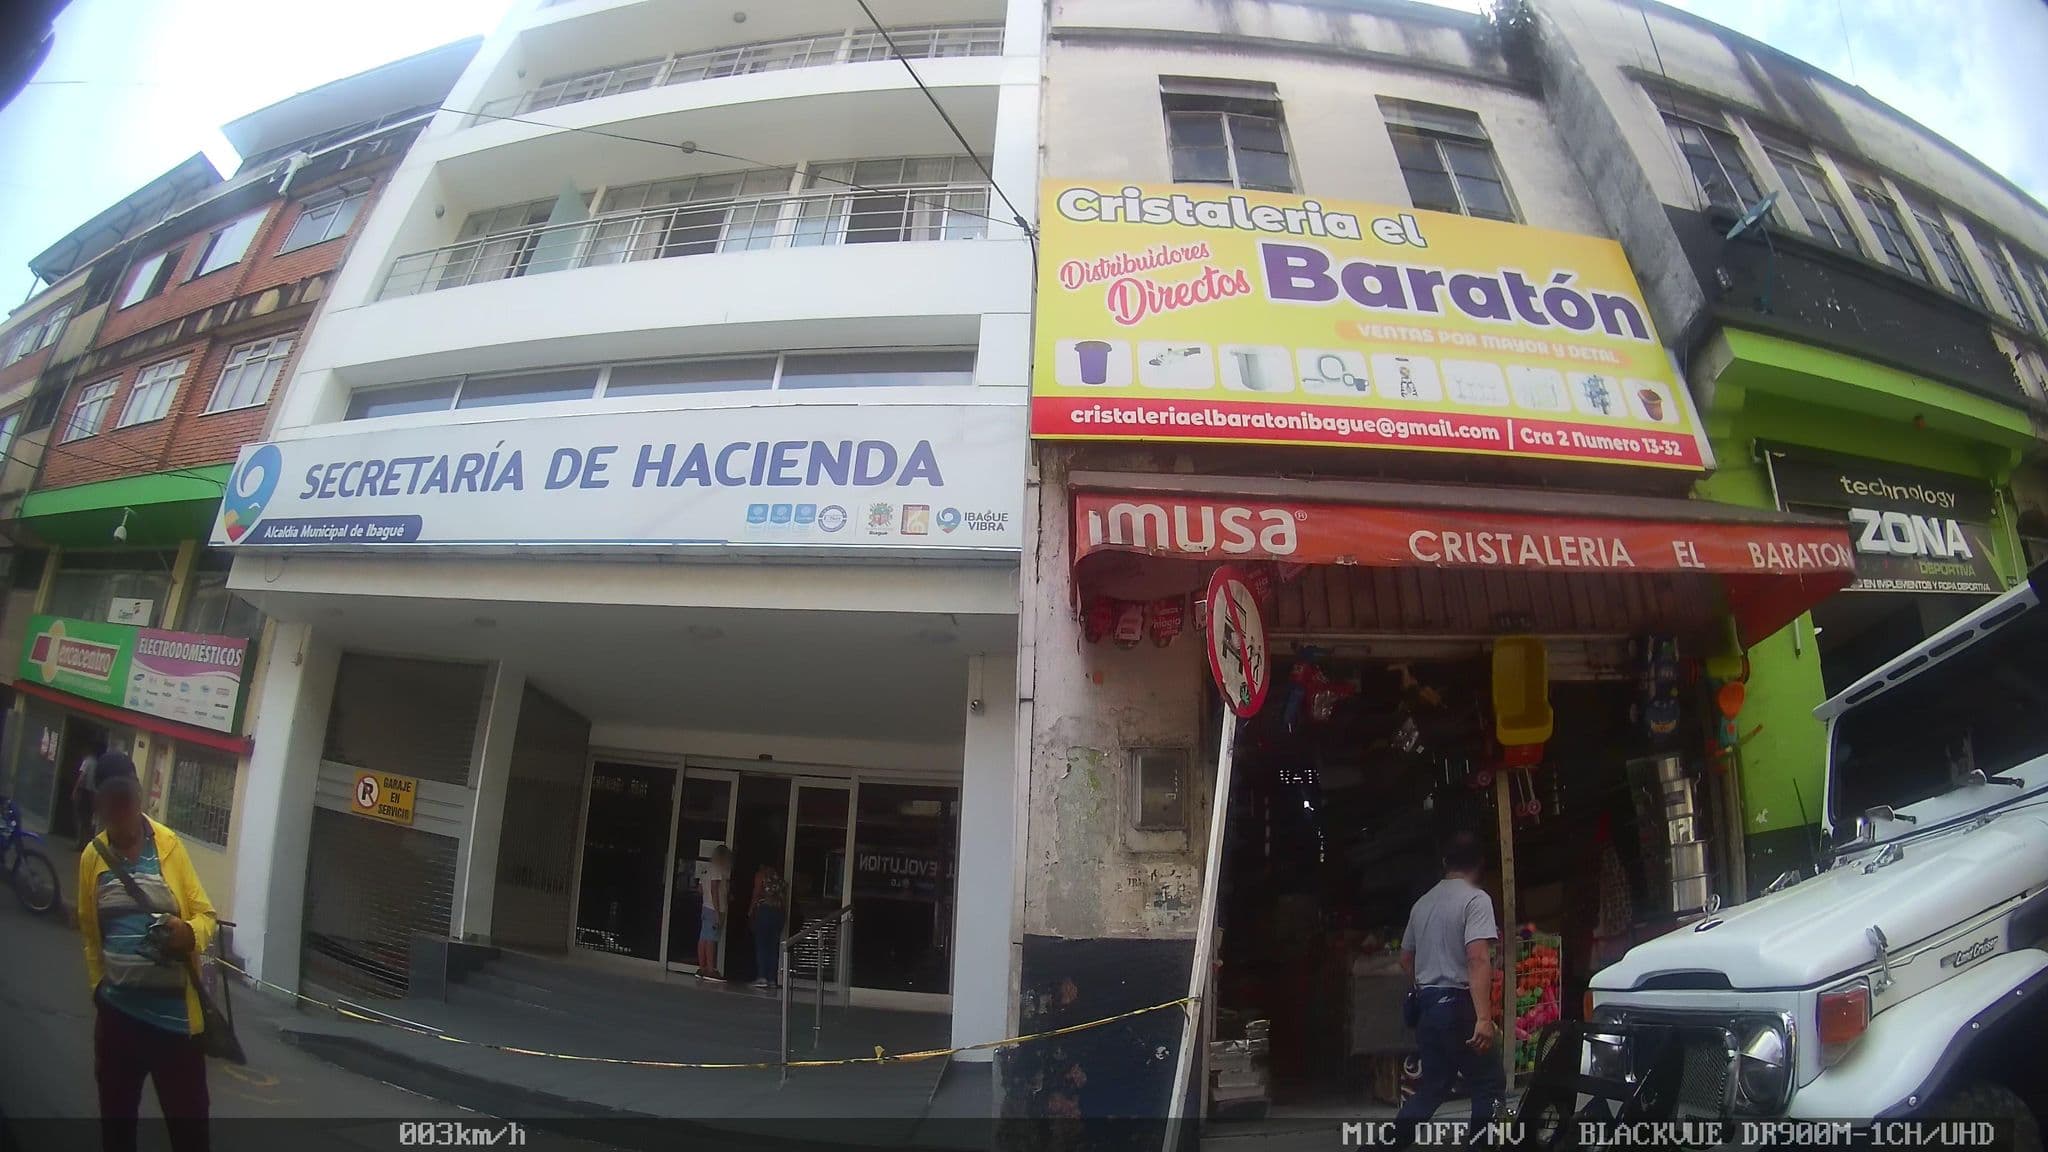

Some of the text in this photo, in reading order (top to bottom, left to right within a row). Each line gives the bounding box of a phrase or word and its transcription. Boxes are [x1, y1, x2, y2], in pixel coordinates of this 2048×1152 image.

[1057, 186, 1428, 248] Cristaleria el
[1060, 243, 1209, 290] Distribuidores
[1108, 266, 1250, 325] Directos
[1262, 243, 1651, 340] Baratón
[1358, 324, 1434, 343] VENTAS
[1438, 330, 1481, 347] POR
[1482, 335, 1549, 355] MAYOR
[1070, 405, 1500, 441] cristaleriaelbaratonibague@gmail.com
[1520, 427, 1554, 446] Cra
[1556, 430, 1570, 447] 2
[1641, 438, 1682, 456] 13-32
[300, 439, 944, 500] SECRETARÍA DE HACIENDA
[1840, 475, 1955, 508] technology
[300, 523, 348, 540] Municipal
[350, 524, 363, 537] de
[366, 523, 404, 540] Ibagué
[968, 521, 1005, 531] VIBRA
[1088, 503, 1298, 556] imusa
[1848, 508, 1974, 560] ZONA
[1408, 530, 1852, 569] CRISTALERIA EL BARATON
[1864, 579, 1876, 589] EN
[1877, 580, 1932, 590] IMPLEMENTOS
[1938, 582, 1957, 591] ROPA
[1957, 583, 1990, 592] DEPORTIVA
[1920, 562, 1976, 577] DEPORTIVA
[139, 637, 242, 666] ELECTRODOMÉSTICOS
[384, 777, 411, 792] GARAJE
[391, 792, 400, 803] EN
